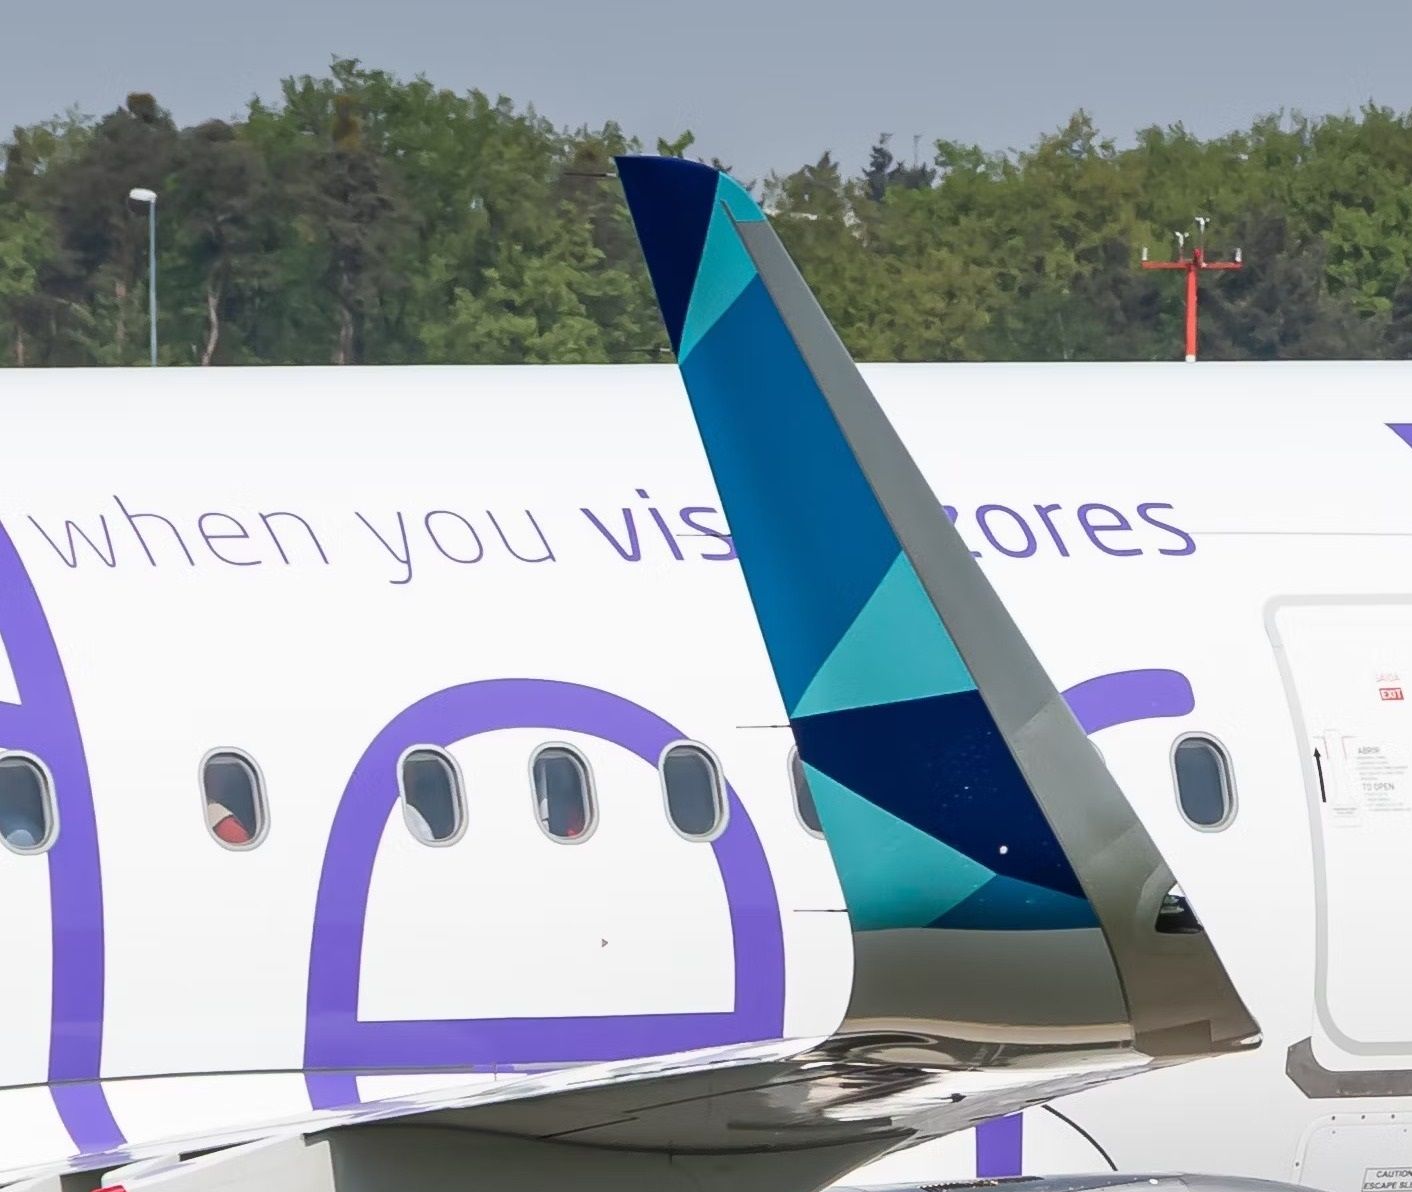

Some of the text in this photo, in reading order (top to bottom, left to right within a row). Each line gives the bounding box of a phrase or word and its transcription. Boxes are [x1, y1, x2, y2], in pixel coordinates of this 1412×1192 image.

[29, 488, 1198, 585] when you vis ores
[1381, 689, 1403, 699] EXIT
[1363, 1181, 1397, 1190] ESCAPE
